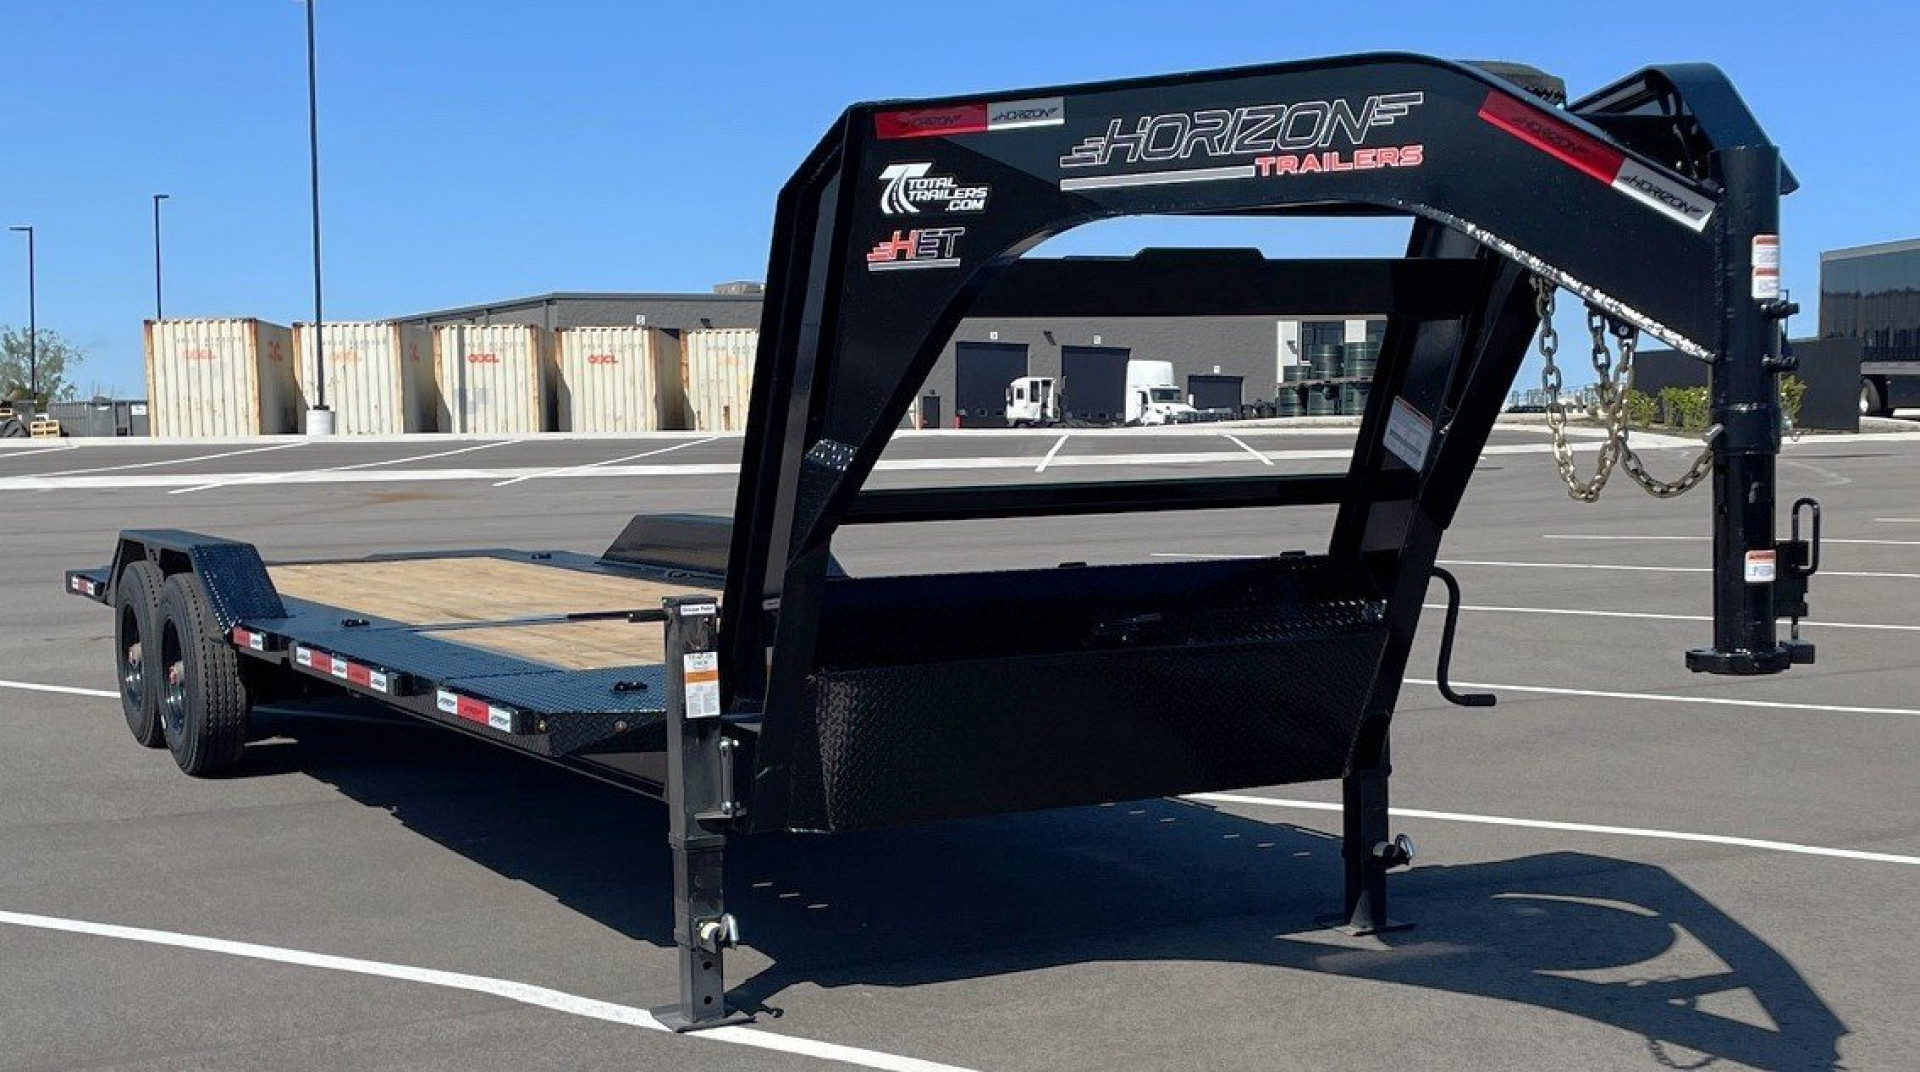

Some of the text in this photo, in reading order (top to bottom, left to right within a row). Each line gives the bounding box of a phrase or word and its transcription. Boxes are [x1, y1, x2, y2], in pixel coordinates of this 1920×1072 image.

[995, 107, 1056, 120] HORIZON
[1080, 95, 1400, 166] HORIZON
[1256, 145, 1424, 177] TRAILERS
[908, 177, 958, 189] TOTAL
[908, 187, 988, 201] TRAILERS
[1625, 175, 1702, 213] HORIZON
[945, 199, 986, 211] .COM
[873, 227, 966, 260] HET
